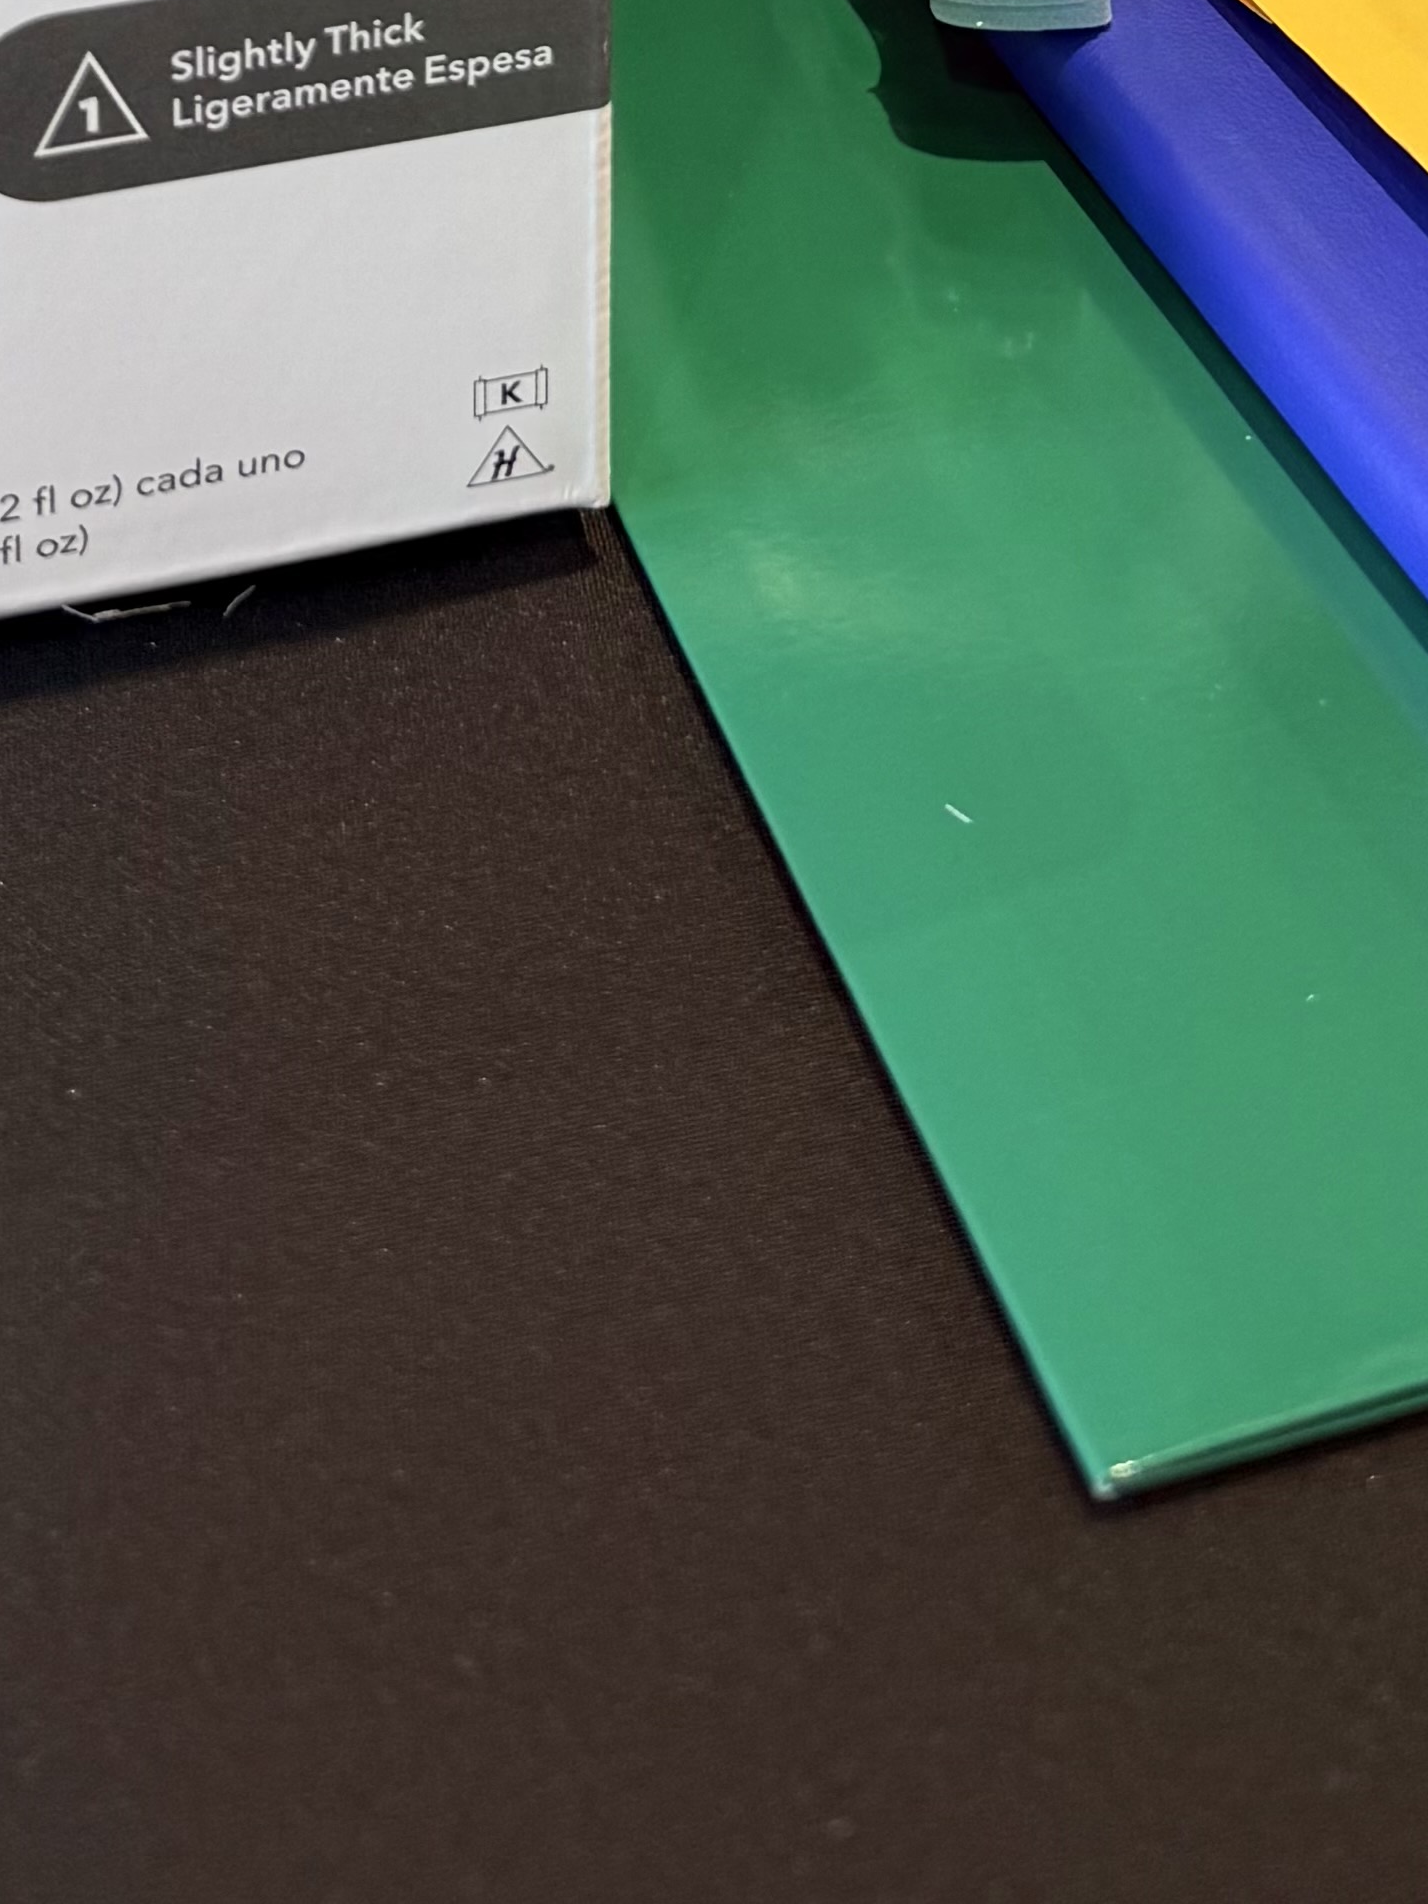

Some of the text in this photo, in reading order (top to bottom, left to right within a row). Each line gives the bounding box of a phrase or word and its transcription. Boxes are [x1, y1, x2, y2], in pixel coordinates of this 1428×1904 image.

[171, 12, 426, 84] Slightly Thick
[78, 96, 101, 134] 1
[172, 43, 555, 131] Ligeramente Espesa
[32, 485, 58, 518] fl
[69, 473, 124, 512] oz)
[135, 456, 224, 499] cada
[236, 445, 307, 479] uno
[35, 524, 90, 561] oz)
